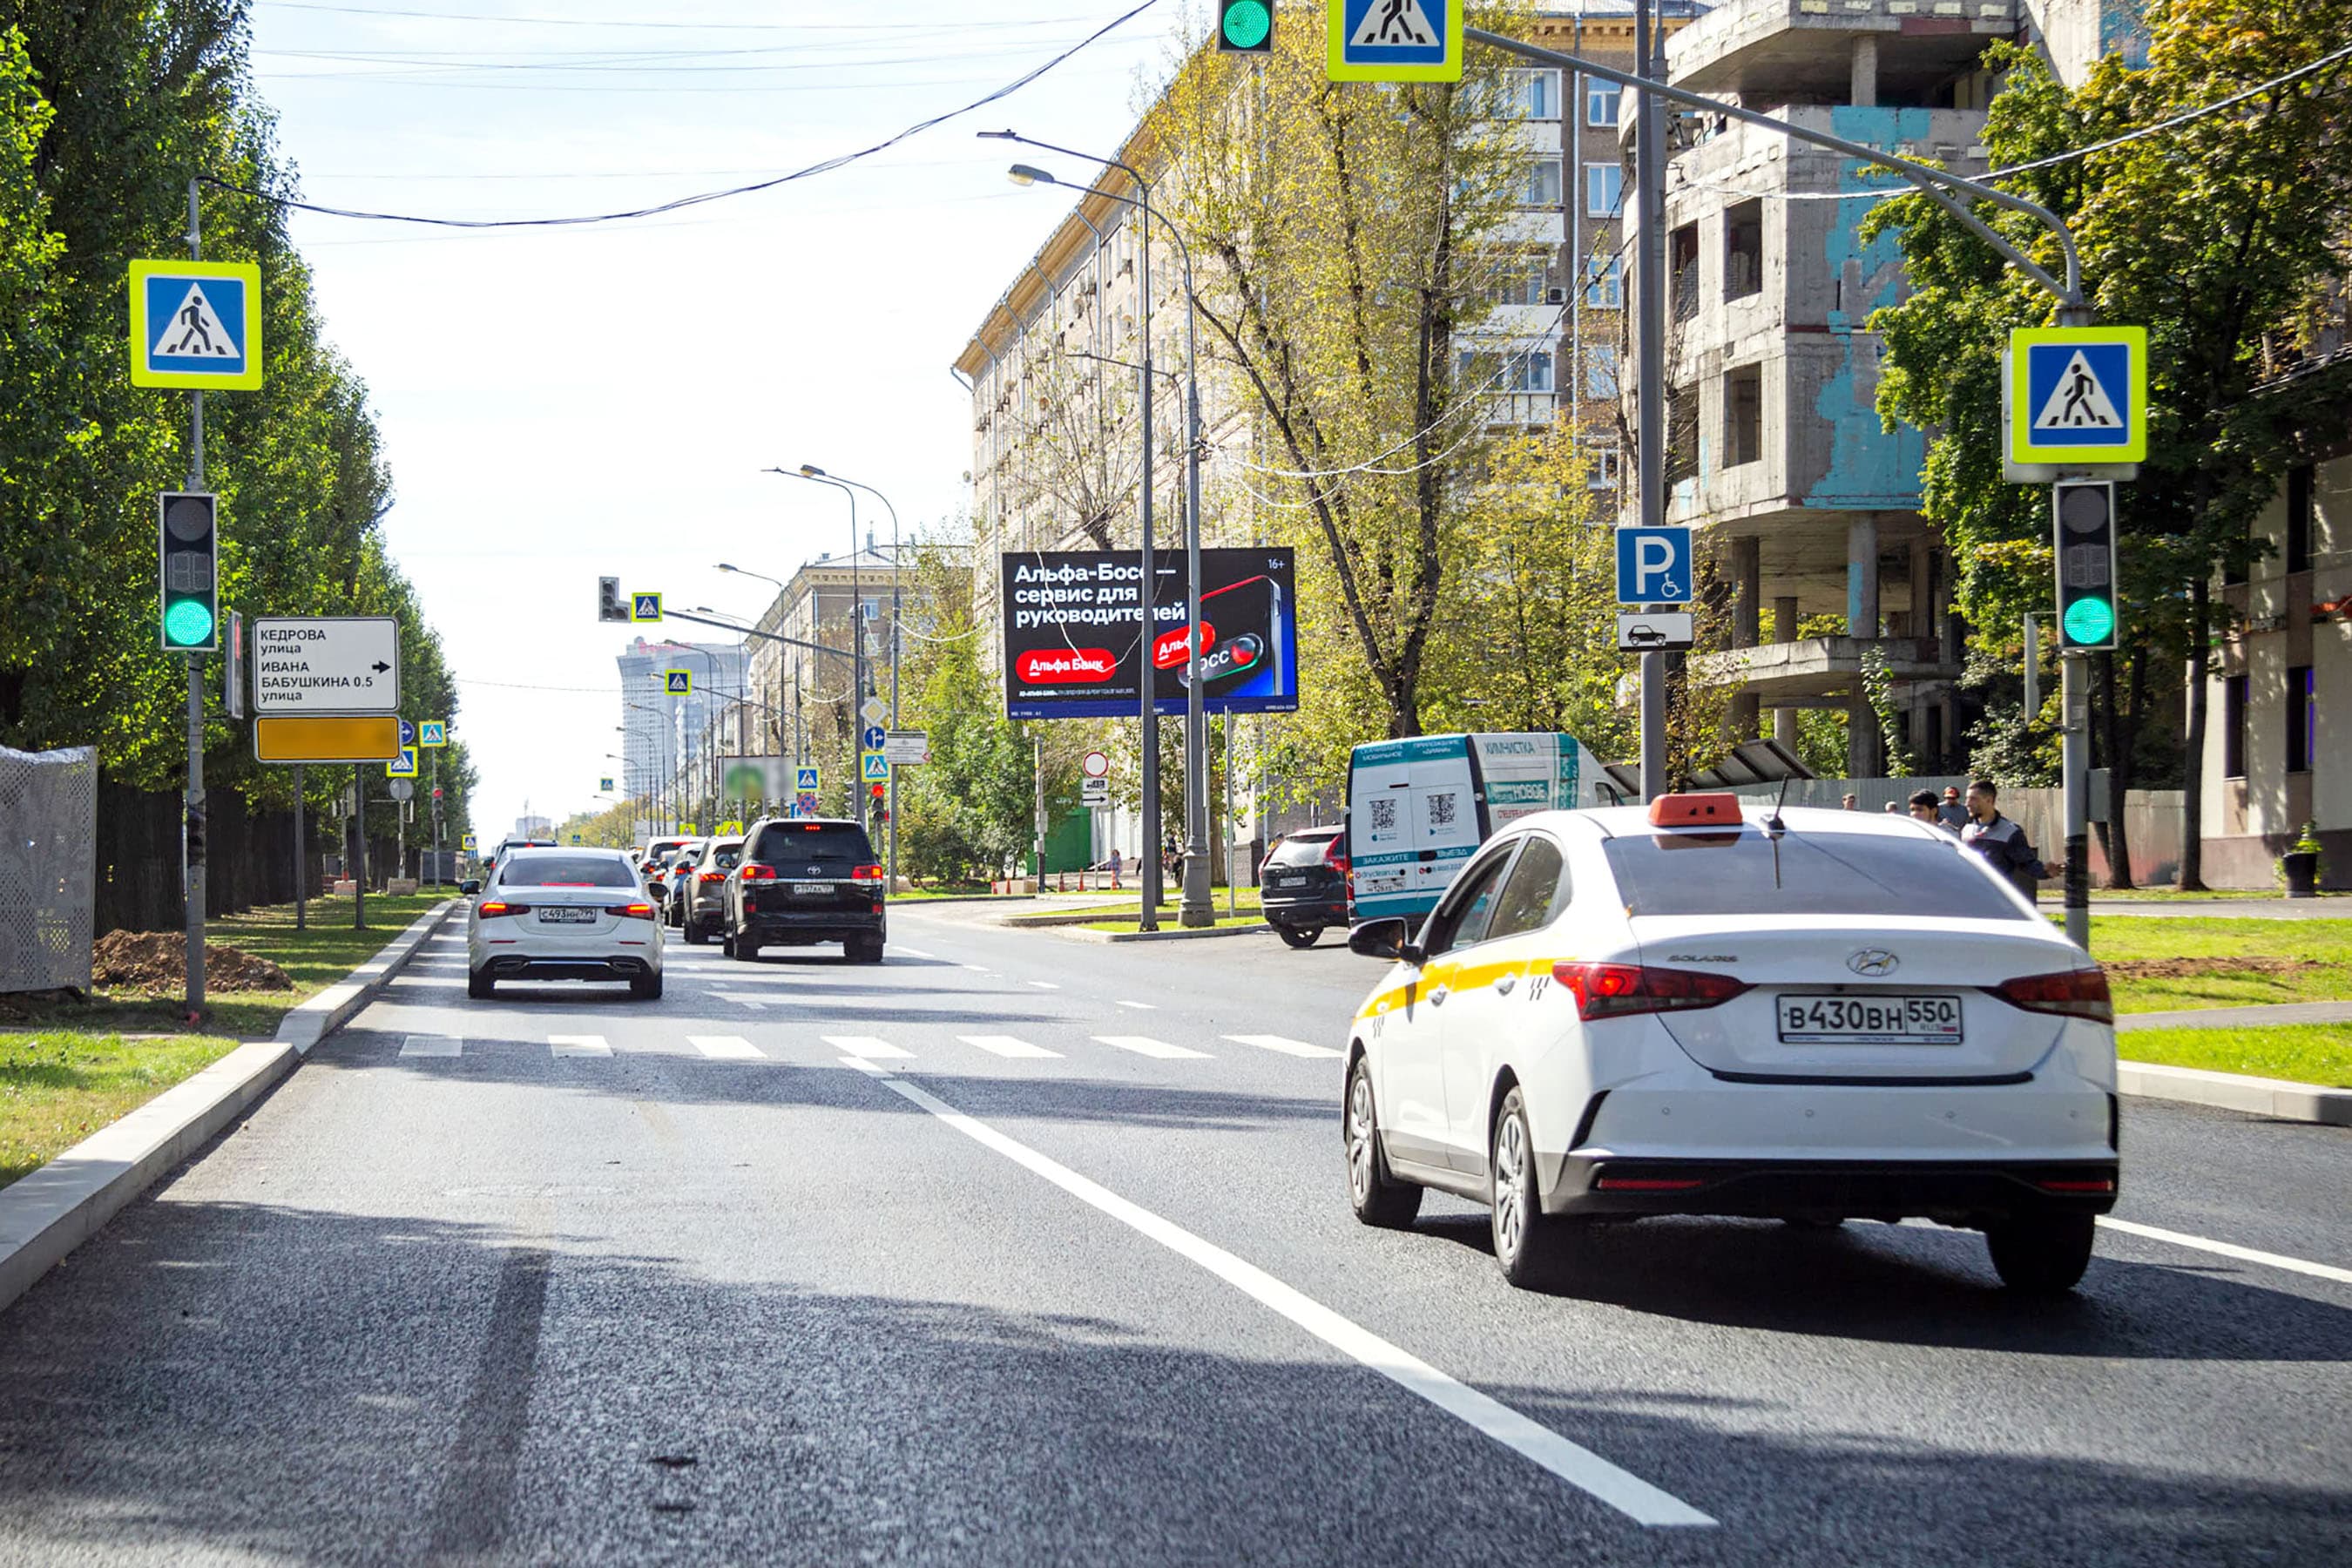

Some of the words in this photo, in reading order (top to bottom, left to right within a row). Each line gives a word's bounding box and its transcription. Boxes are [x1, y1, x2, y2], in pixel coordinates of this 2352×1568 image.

[1268, 558, 1285, 569] 16+
[1015, 589, 1093, 606] сервис
[1097, 587, 1138, 604] для
[260, 630, 327, 641] КЕДРОВА
[260, 645, 301, 656] улица
[261, 662, 309, 672] ИВАНА
[1029, 659, 1071, 676] Альфа
[1072, 659, 1105, 671] Банк
[262, 677, 350, 687] БАБУШКИНА
[354, 677, 373, 687] 0.5
[261, 692, 302, 703] улица
[1484, 741, 1536, 754] ХИМЧИСТКА
[1513, 783, 1546, 801] НОВОЕ
[1363, 853, 1409, 865] ЗАКАЖИТЕ
[1788, 1001, 1903, 1030] В430ВН
[1908, 1001, 1952, 1023] 550
